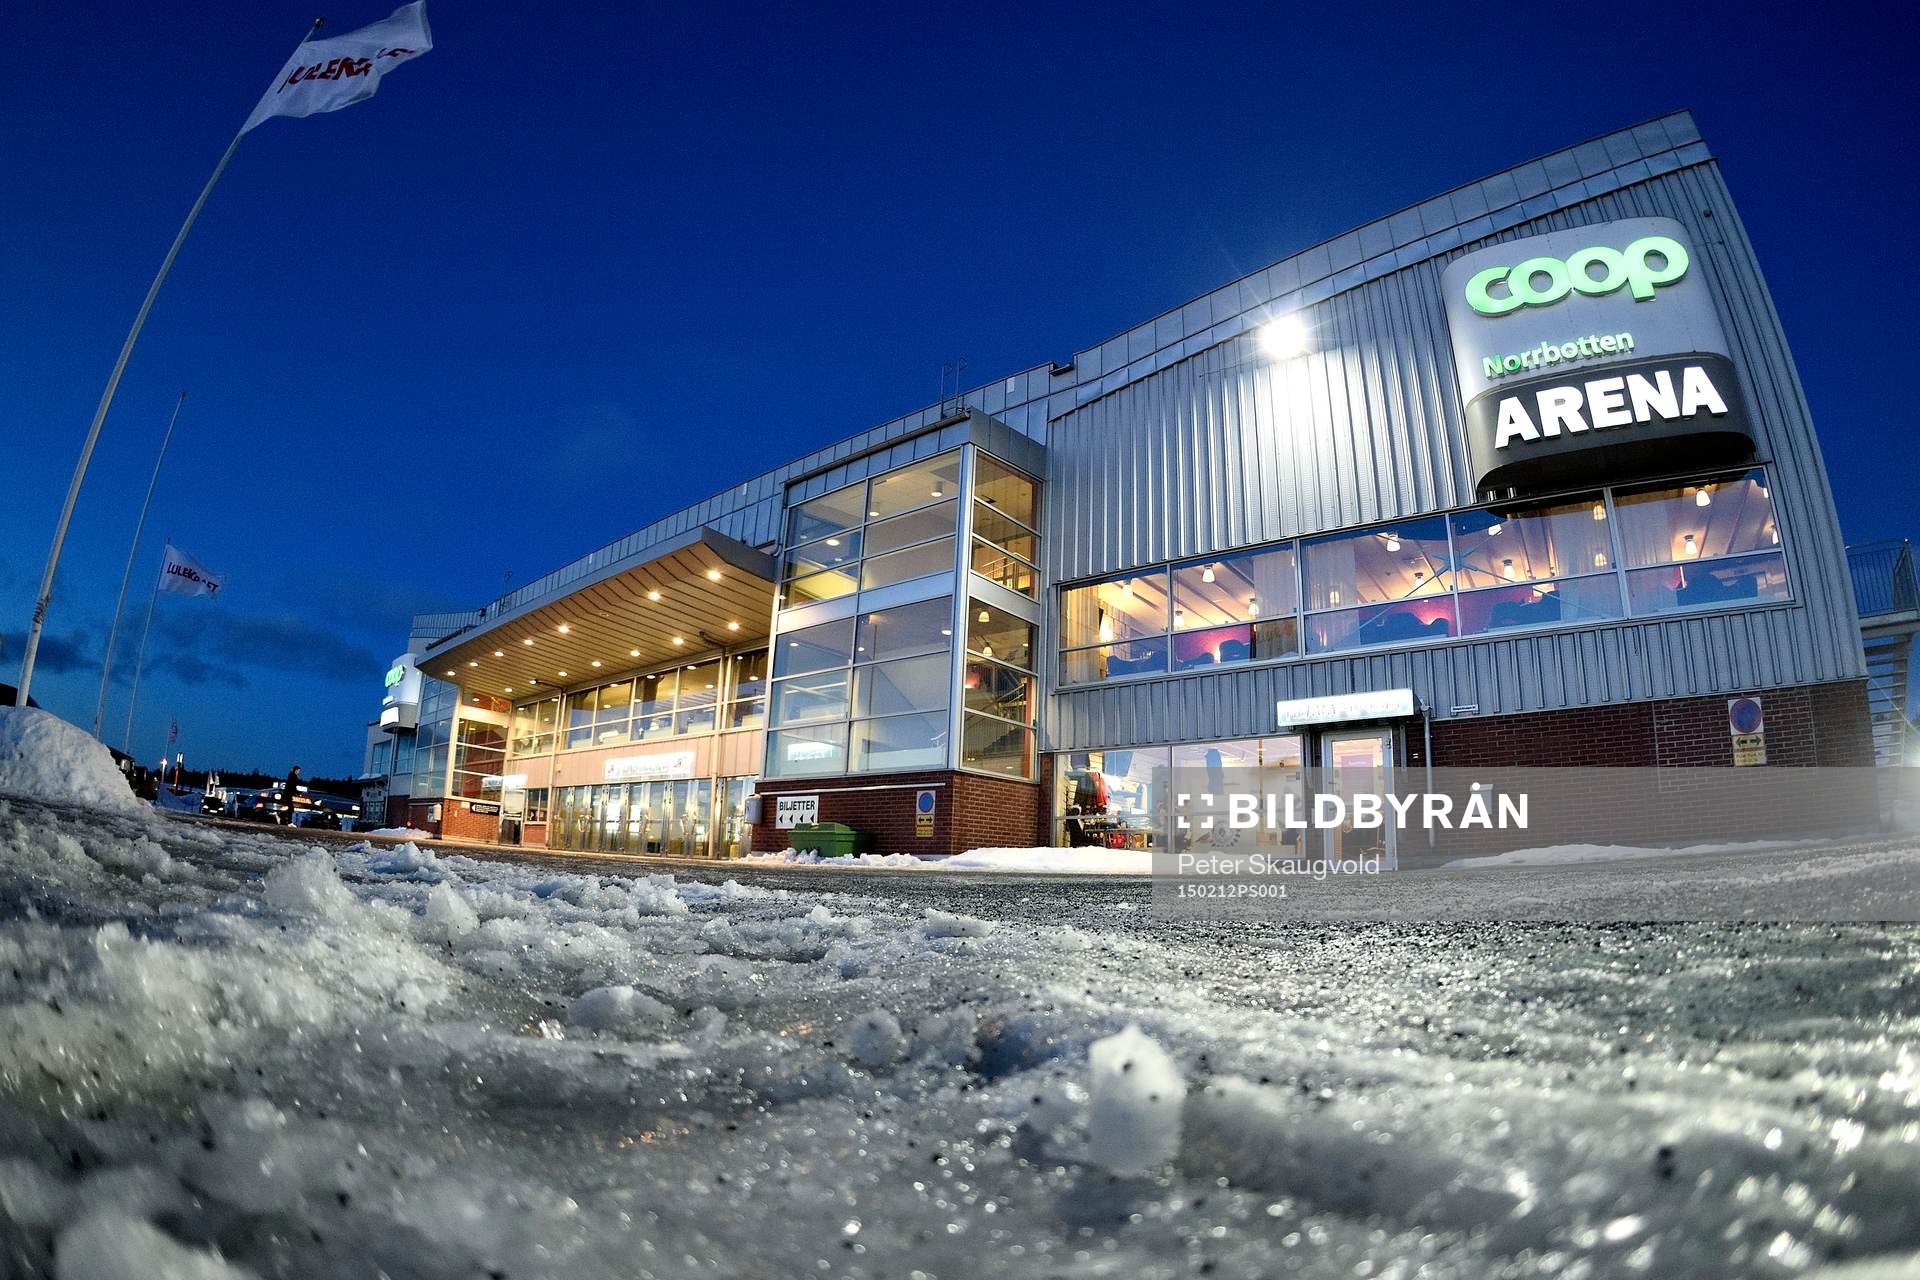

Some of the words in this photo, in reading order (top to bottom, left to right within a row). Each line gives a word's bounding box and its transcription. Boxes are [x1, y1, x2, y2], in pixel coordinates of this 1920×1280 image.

[1464, 236, 1690, 318] coop
[1482, 331, 1635, 379] Norrbotten
[1494, 366, 1729, 451] ARENA
[779, 800, 816, 811] BILJETTER
